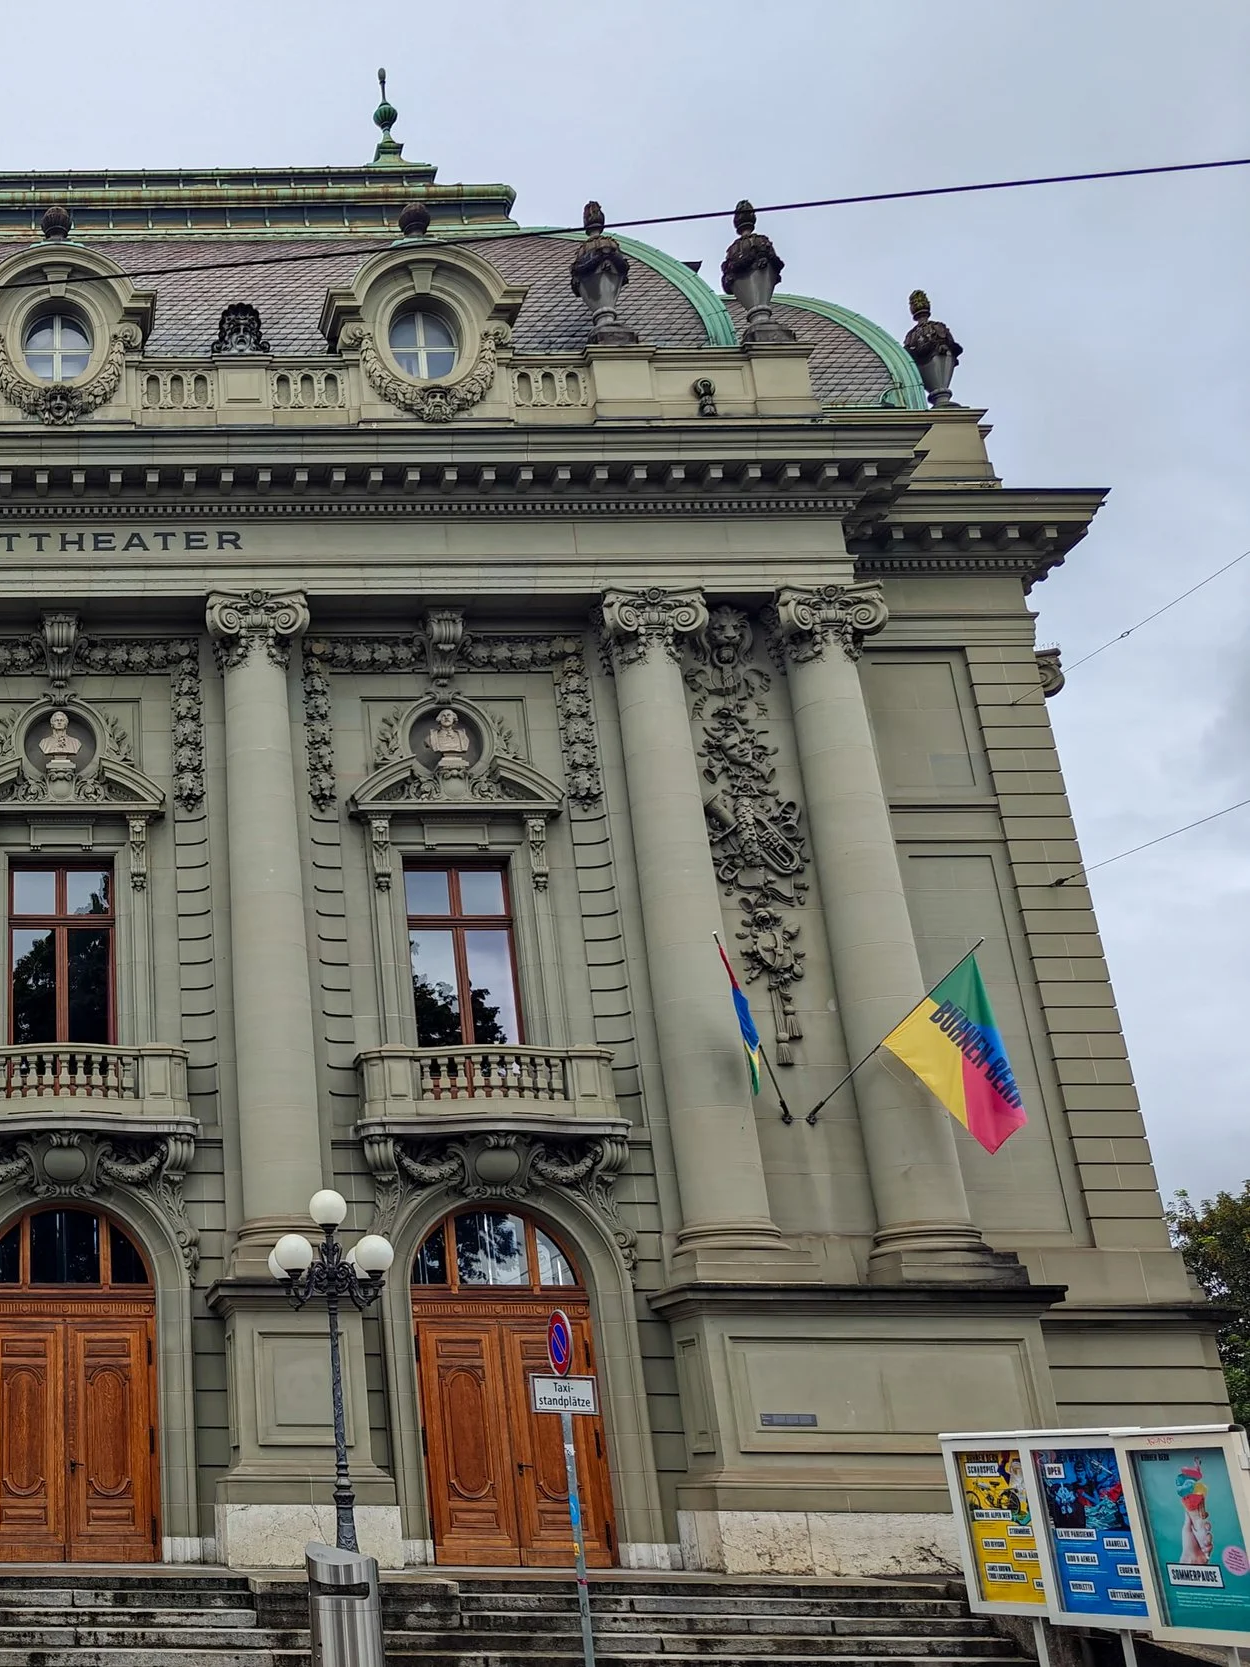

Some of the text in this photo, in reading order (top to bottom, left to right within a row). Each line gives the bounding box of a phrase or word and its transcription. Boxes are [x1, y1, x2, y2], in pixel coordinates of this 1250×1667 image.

[553, 1382, 574, 1392] Taxi-
[539, 1396, 591, 1408] standplätze
[1047, 1466, 1062, 1476] OPER
[1171, 1568, 1219, 1583] SOMMERPAUSE
